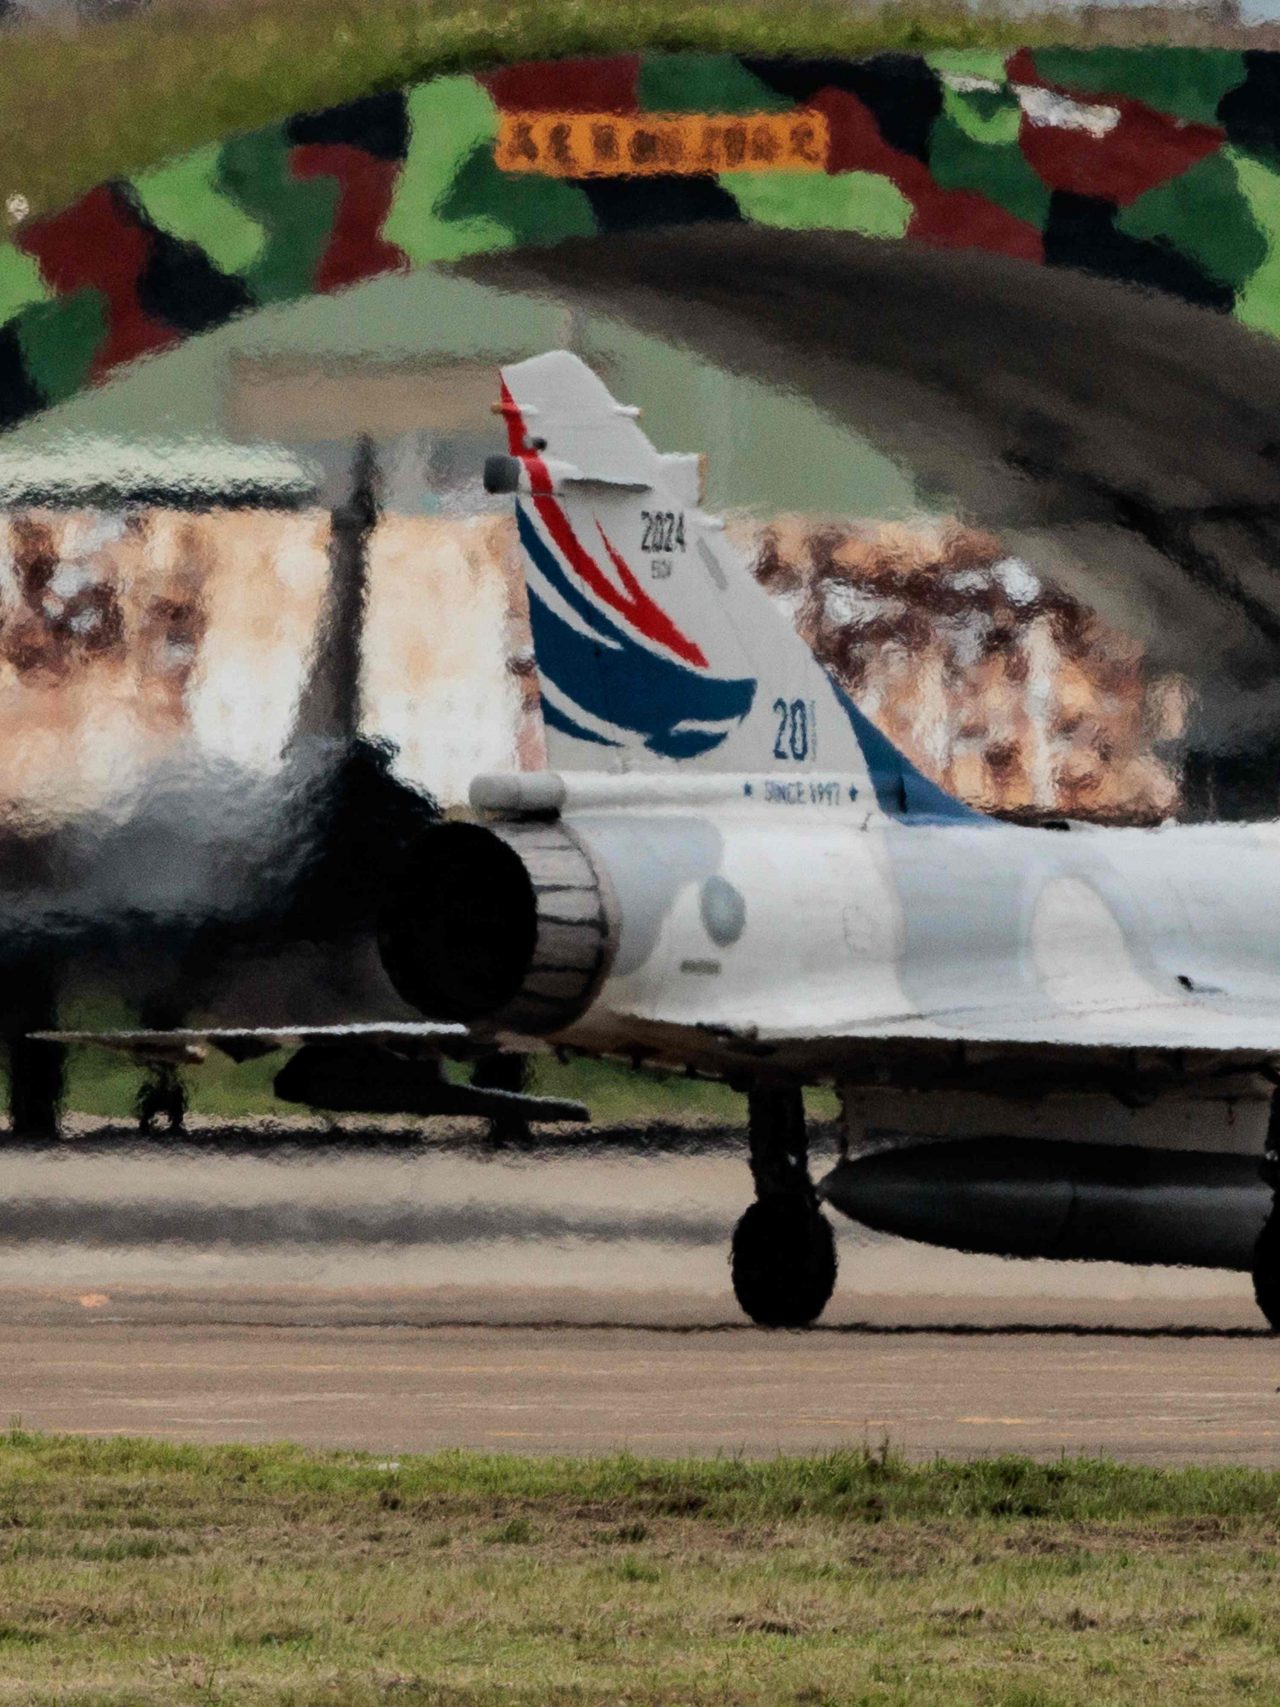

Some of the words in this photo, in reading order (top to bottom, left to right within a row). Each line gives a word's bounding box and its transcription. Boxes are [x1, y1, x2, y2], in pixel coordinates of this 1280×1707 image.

[641, 511, 686, 554] 2024
[773, 698, 807, 761] 20
[764, 781, 806, 805] SINCE
